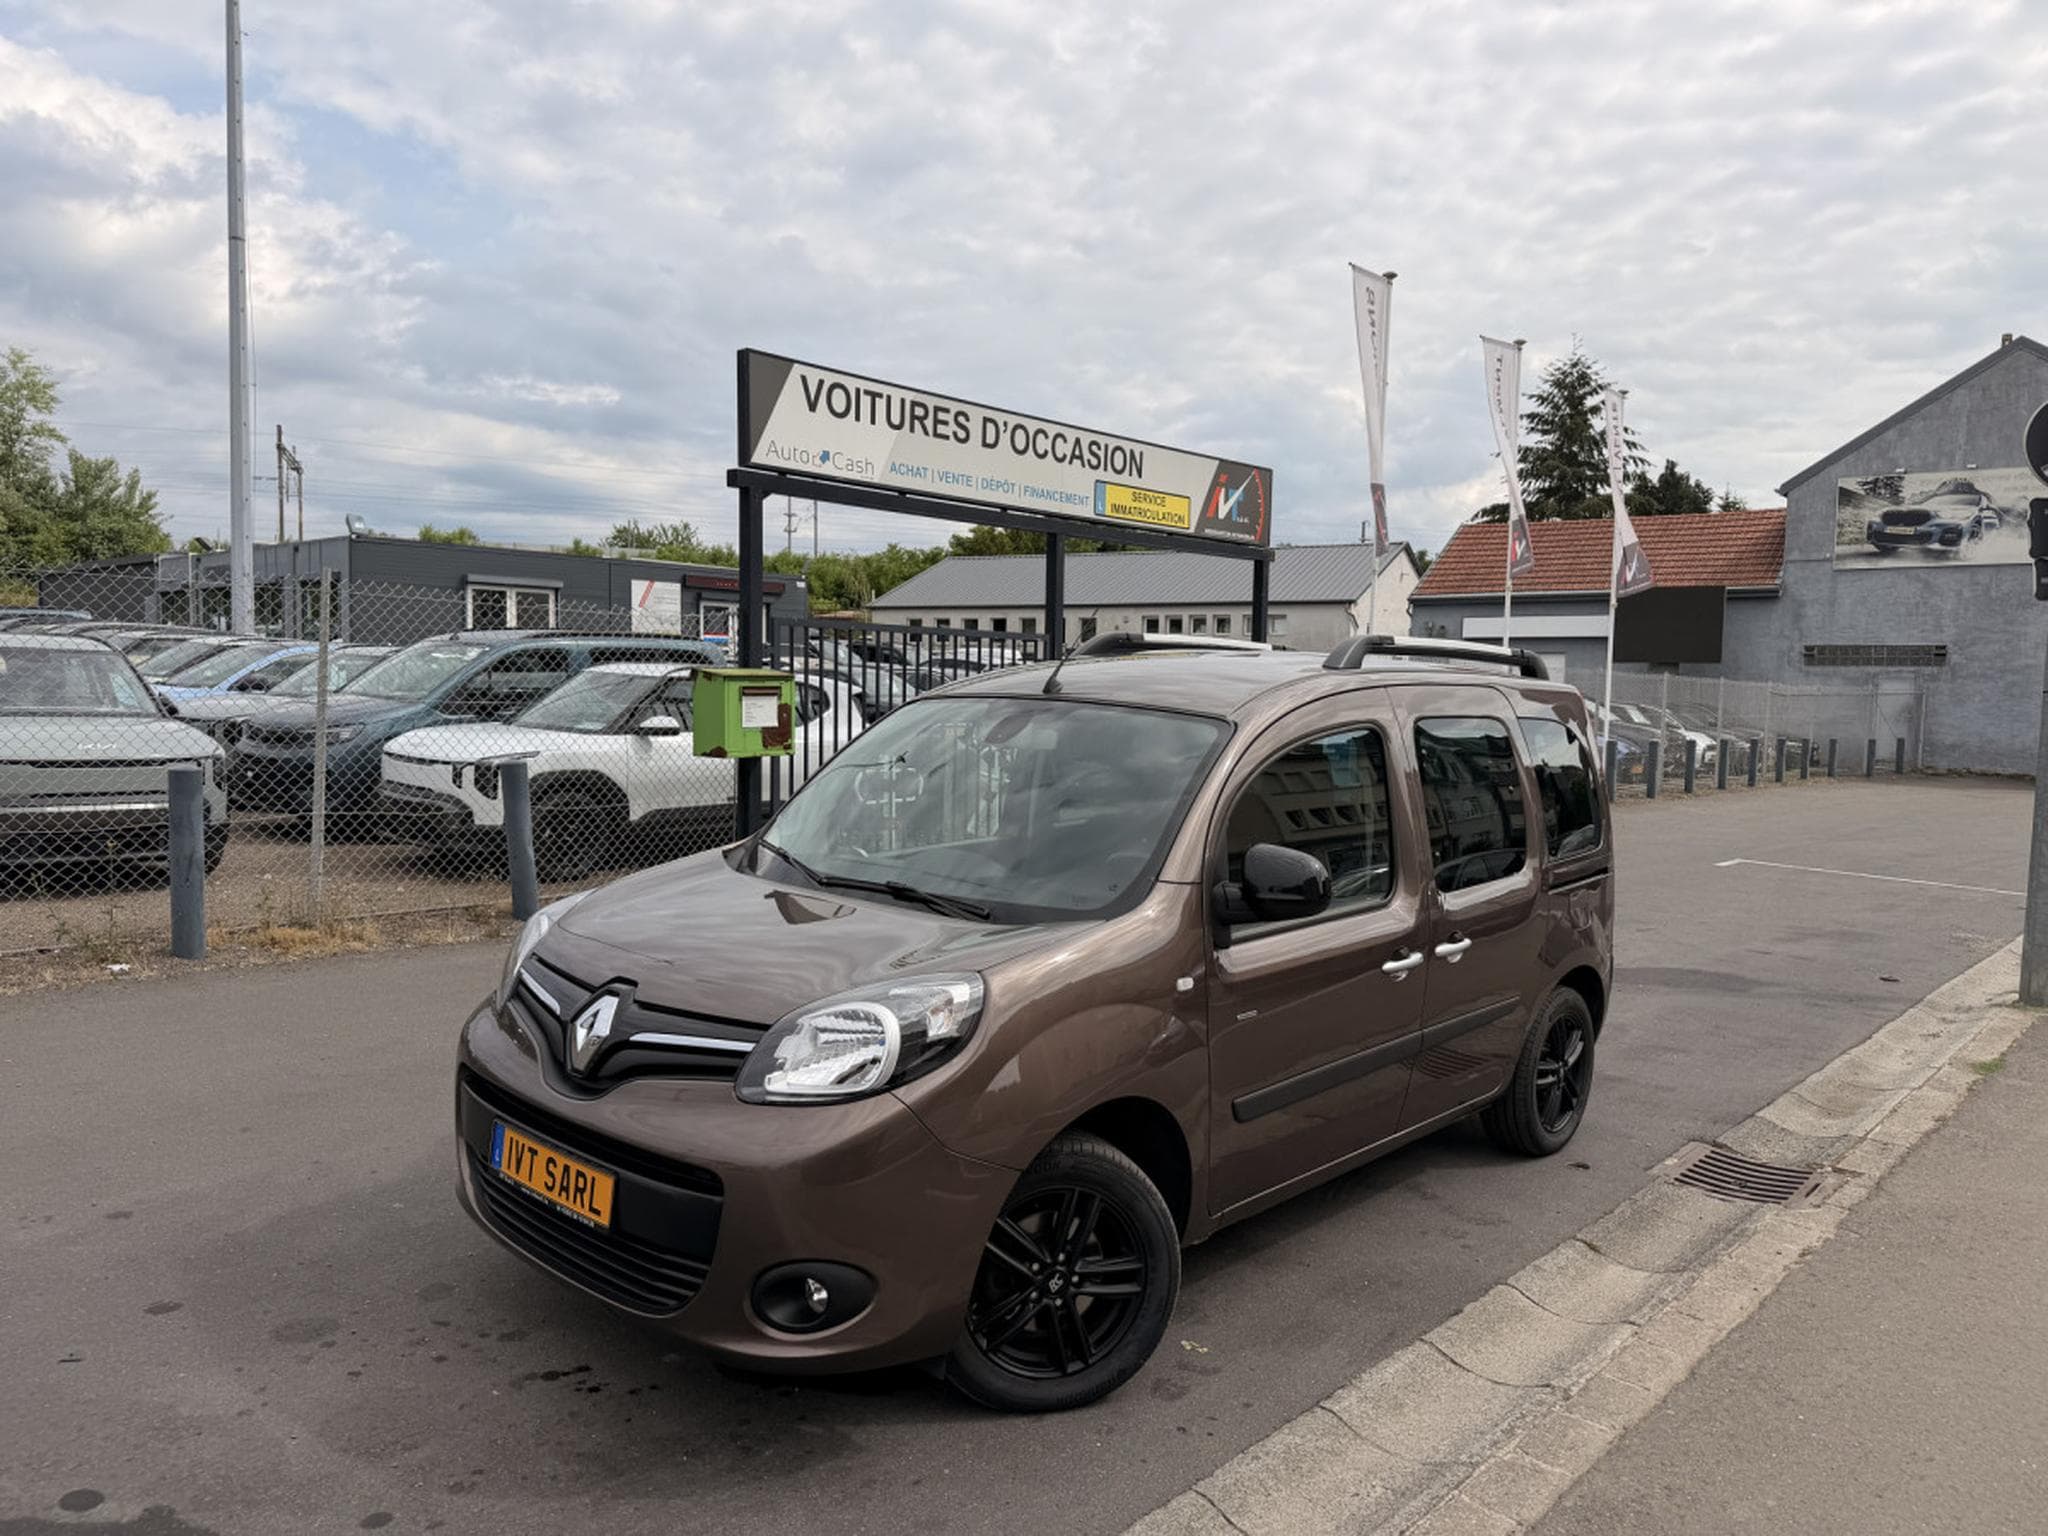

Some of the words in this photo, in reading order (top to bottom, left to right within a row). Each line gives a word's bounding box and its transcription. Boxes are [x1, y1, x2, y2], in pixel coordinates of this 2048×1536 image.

[800, 374, 970, 444] VOITURES
[981, 416, 1144, 479] D'OCCASION
[832, 451, 875, 475] Cash
[889, 461, 929, 479] ACHAT
[936, 470, 973, 487] VENTE
[981, 475, 1016, 494] DÉPÔT
[1023, 485, 1090, 507] FINANCEMENT
[1131, 491, 1167, 508] SERVICE
[1110, 503, 1185, 525] IMMATRICULATION
[507, 1136, 538, 1182] IVT
[544, 1156, 602, 1217] SARL
